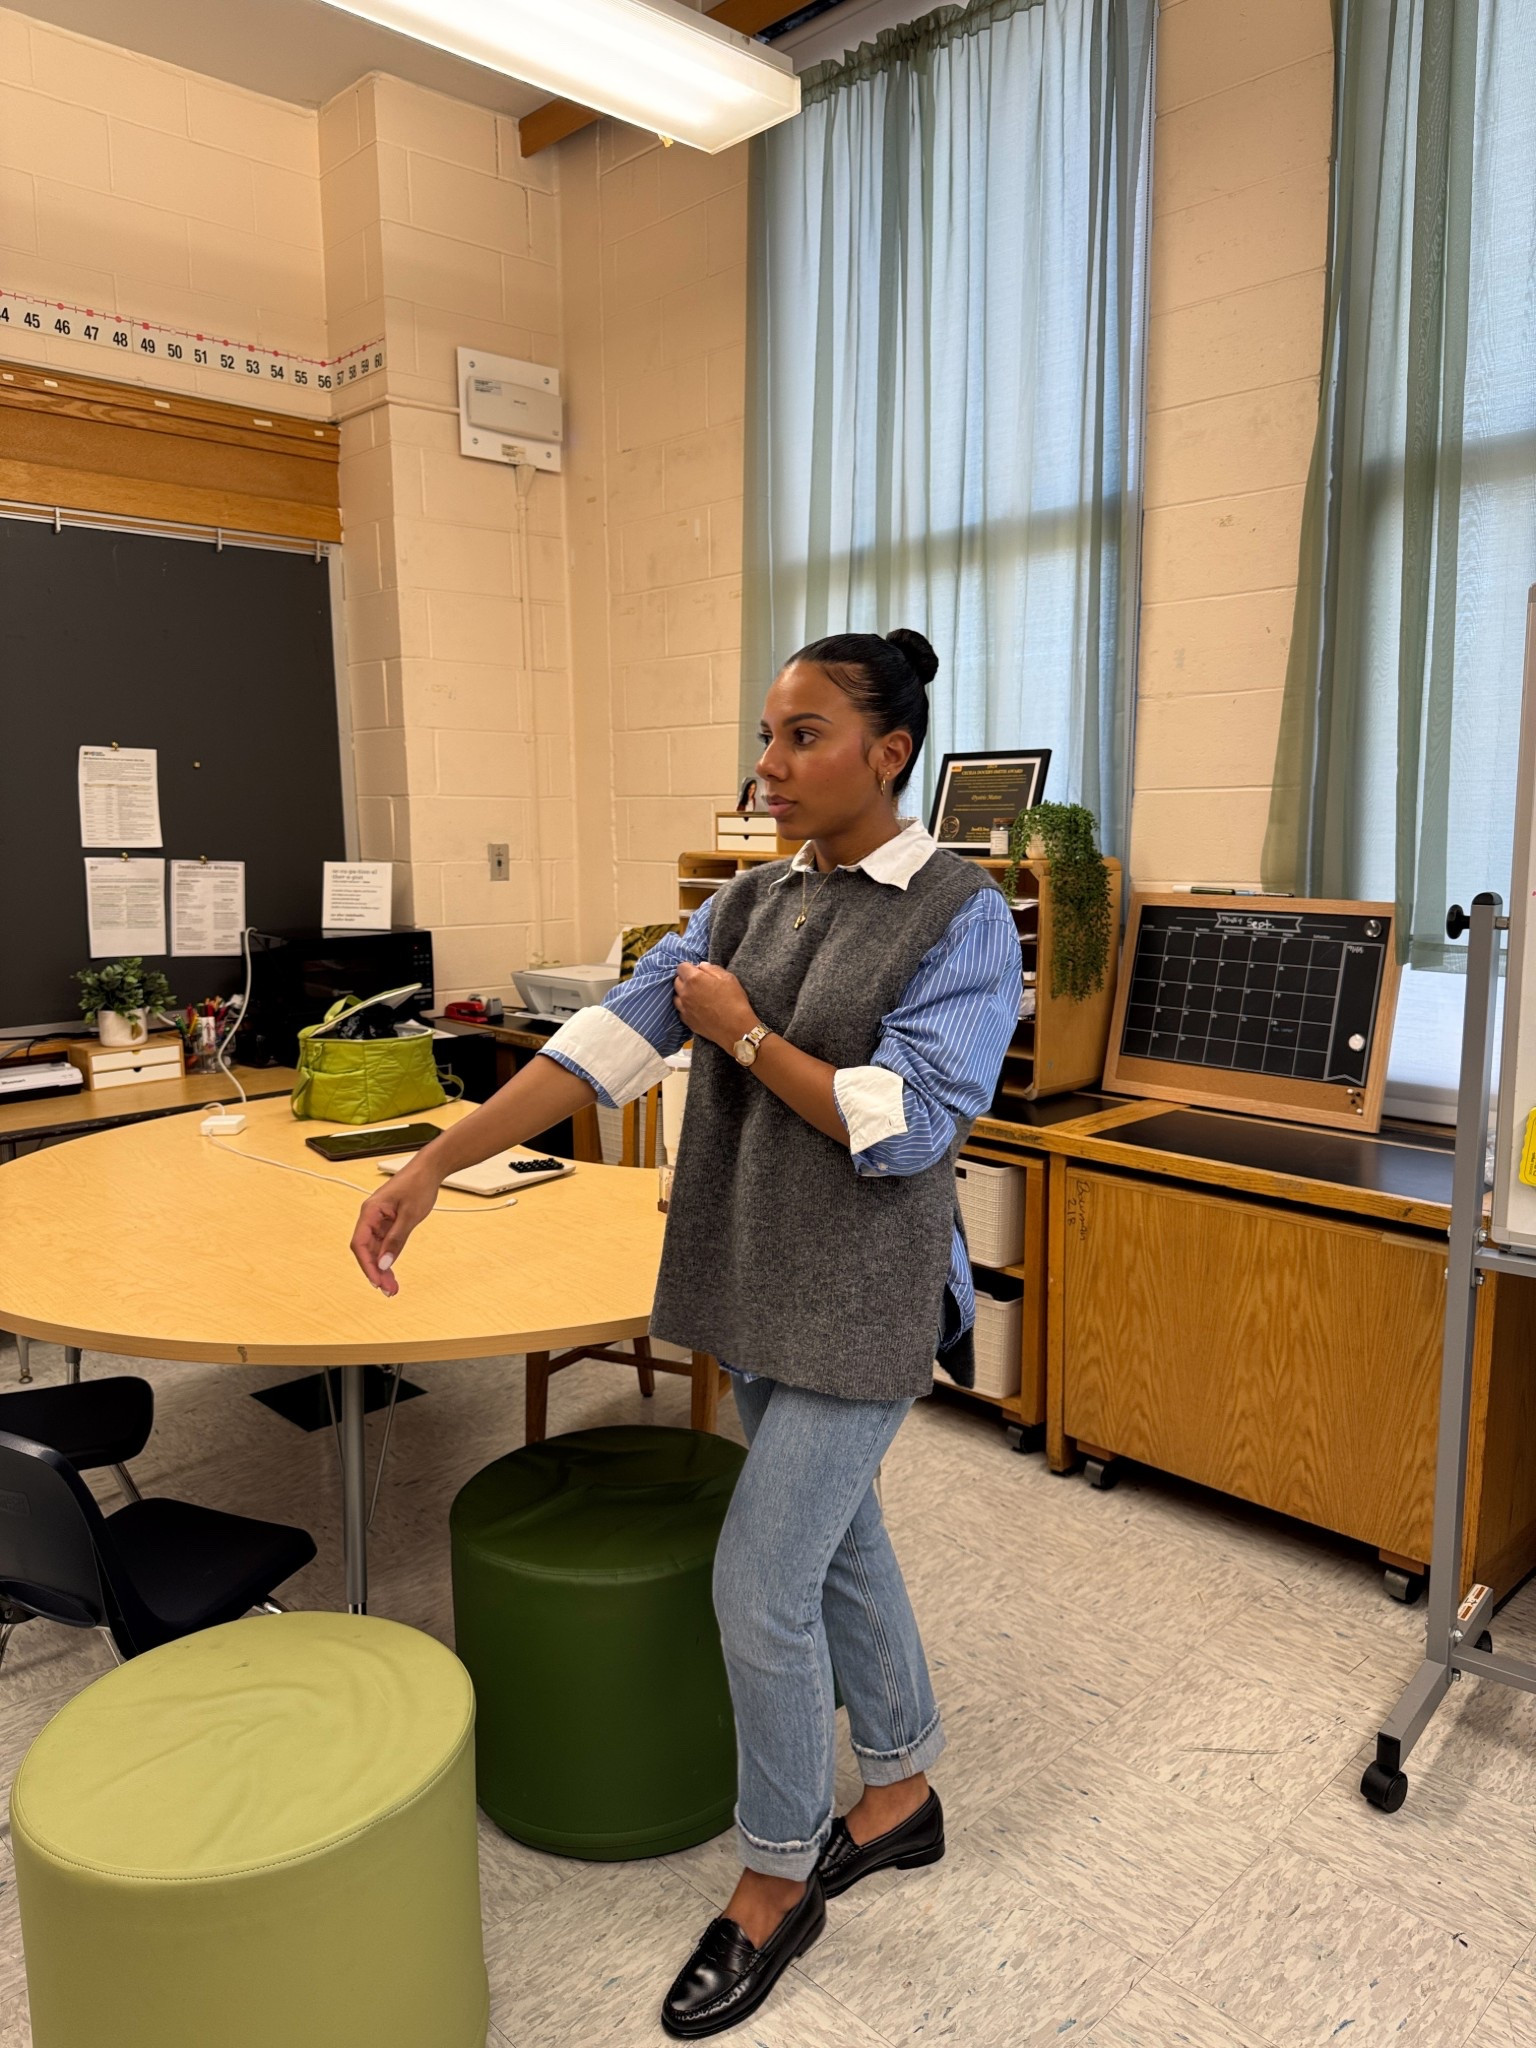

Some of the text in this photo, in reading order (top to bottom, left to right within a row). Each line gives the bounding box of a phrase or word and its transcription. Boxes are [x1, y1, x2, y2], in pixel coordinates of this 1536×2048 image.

[0, 307, 10, 322] 4
[24, 312, 41, 329] 45
[54, 318, 71, 335] 46
[83, 325, 99, 341] 47
[112, 331, 128, 347] 48
[140, 337, 156, 353] 49
[167, 343, 183, 359] 50
[194, 349, 208, 364] 51
[220, 354, 235, 369] 52
[246, 359, 260, 375] 53
[270, 364, 284, 379] 54
[294, 370, 308, 385] 55
[317, 375, 332, 389] 56
[336, 370, 345, 386] 57
[348, 364, 357, 380] 58
[374, 352, 383, 368] 60
[1246, 917, 1275, 930] Sept.
